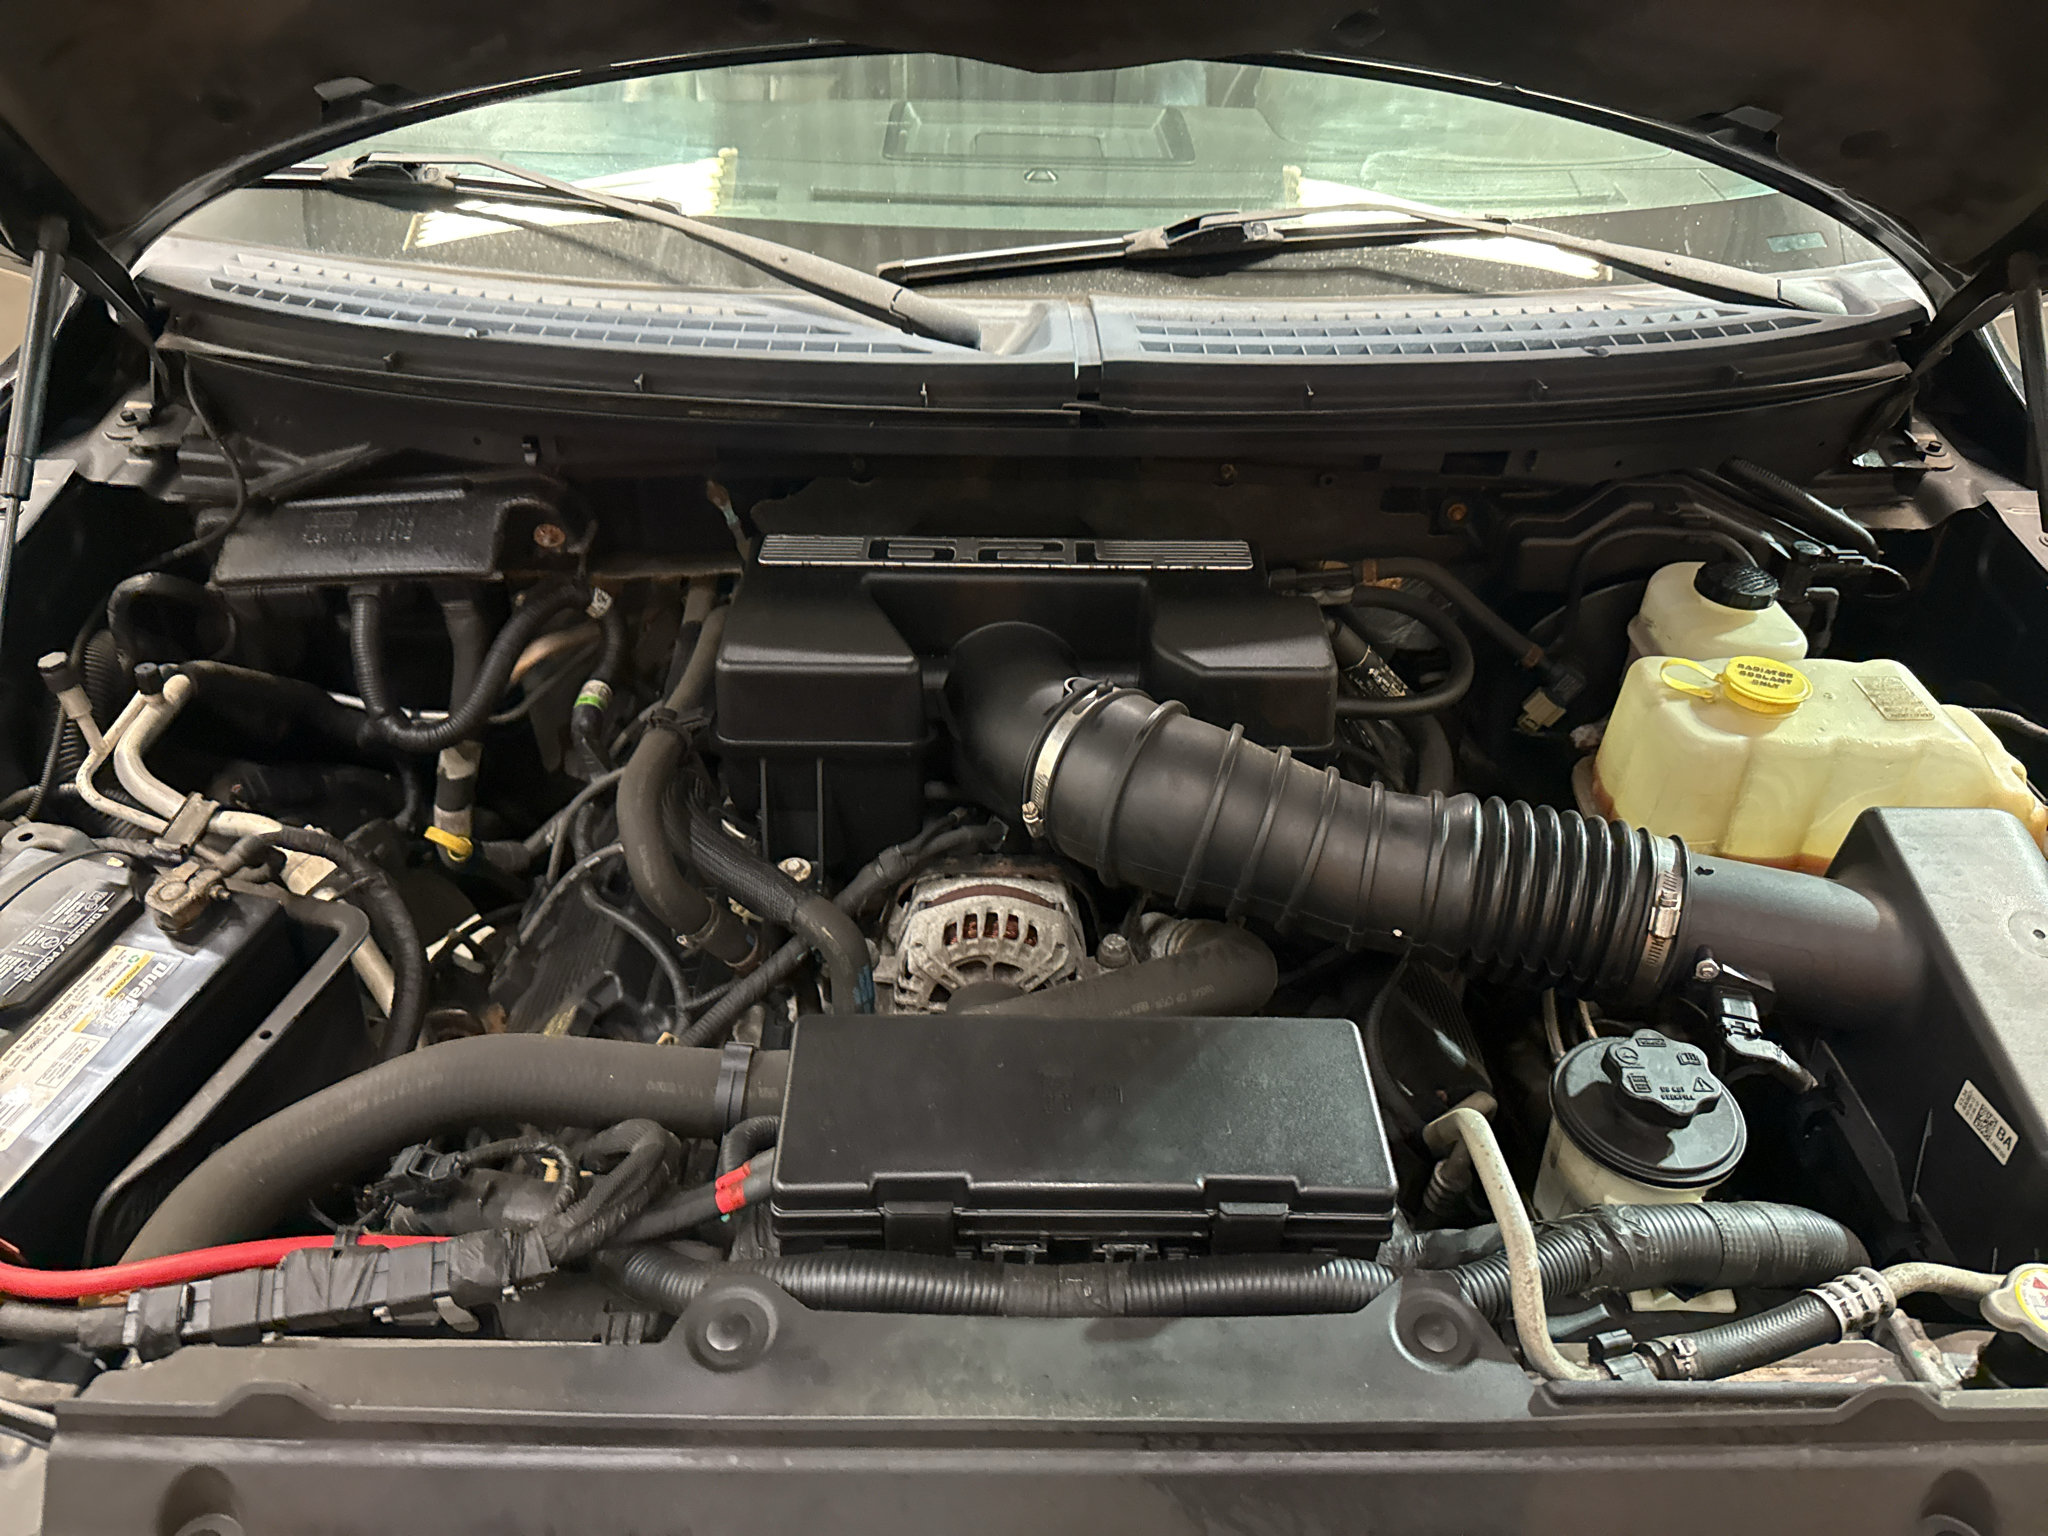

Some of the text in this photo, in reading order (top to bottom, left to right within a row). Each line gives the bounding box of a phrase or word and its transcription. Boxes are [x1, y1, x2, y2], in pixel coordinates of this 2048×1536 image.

[1737, 663, 1794, 678] RADIATOR
[1739, 670, 1792, 685] COOLANT
[1751, 679, 1780, 689] ONLY
[64, 913, 103, 945] DANGER
[24, 951, 60, 982] POISON
[1996, 1126, 2013, 1151] BA
